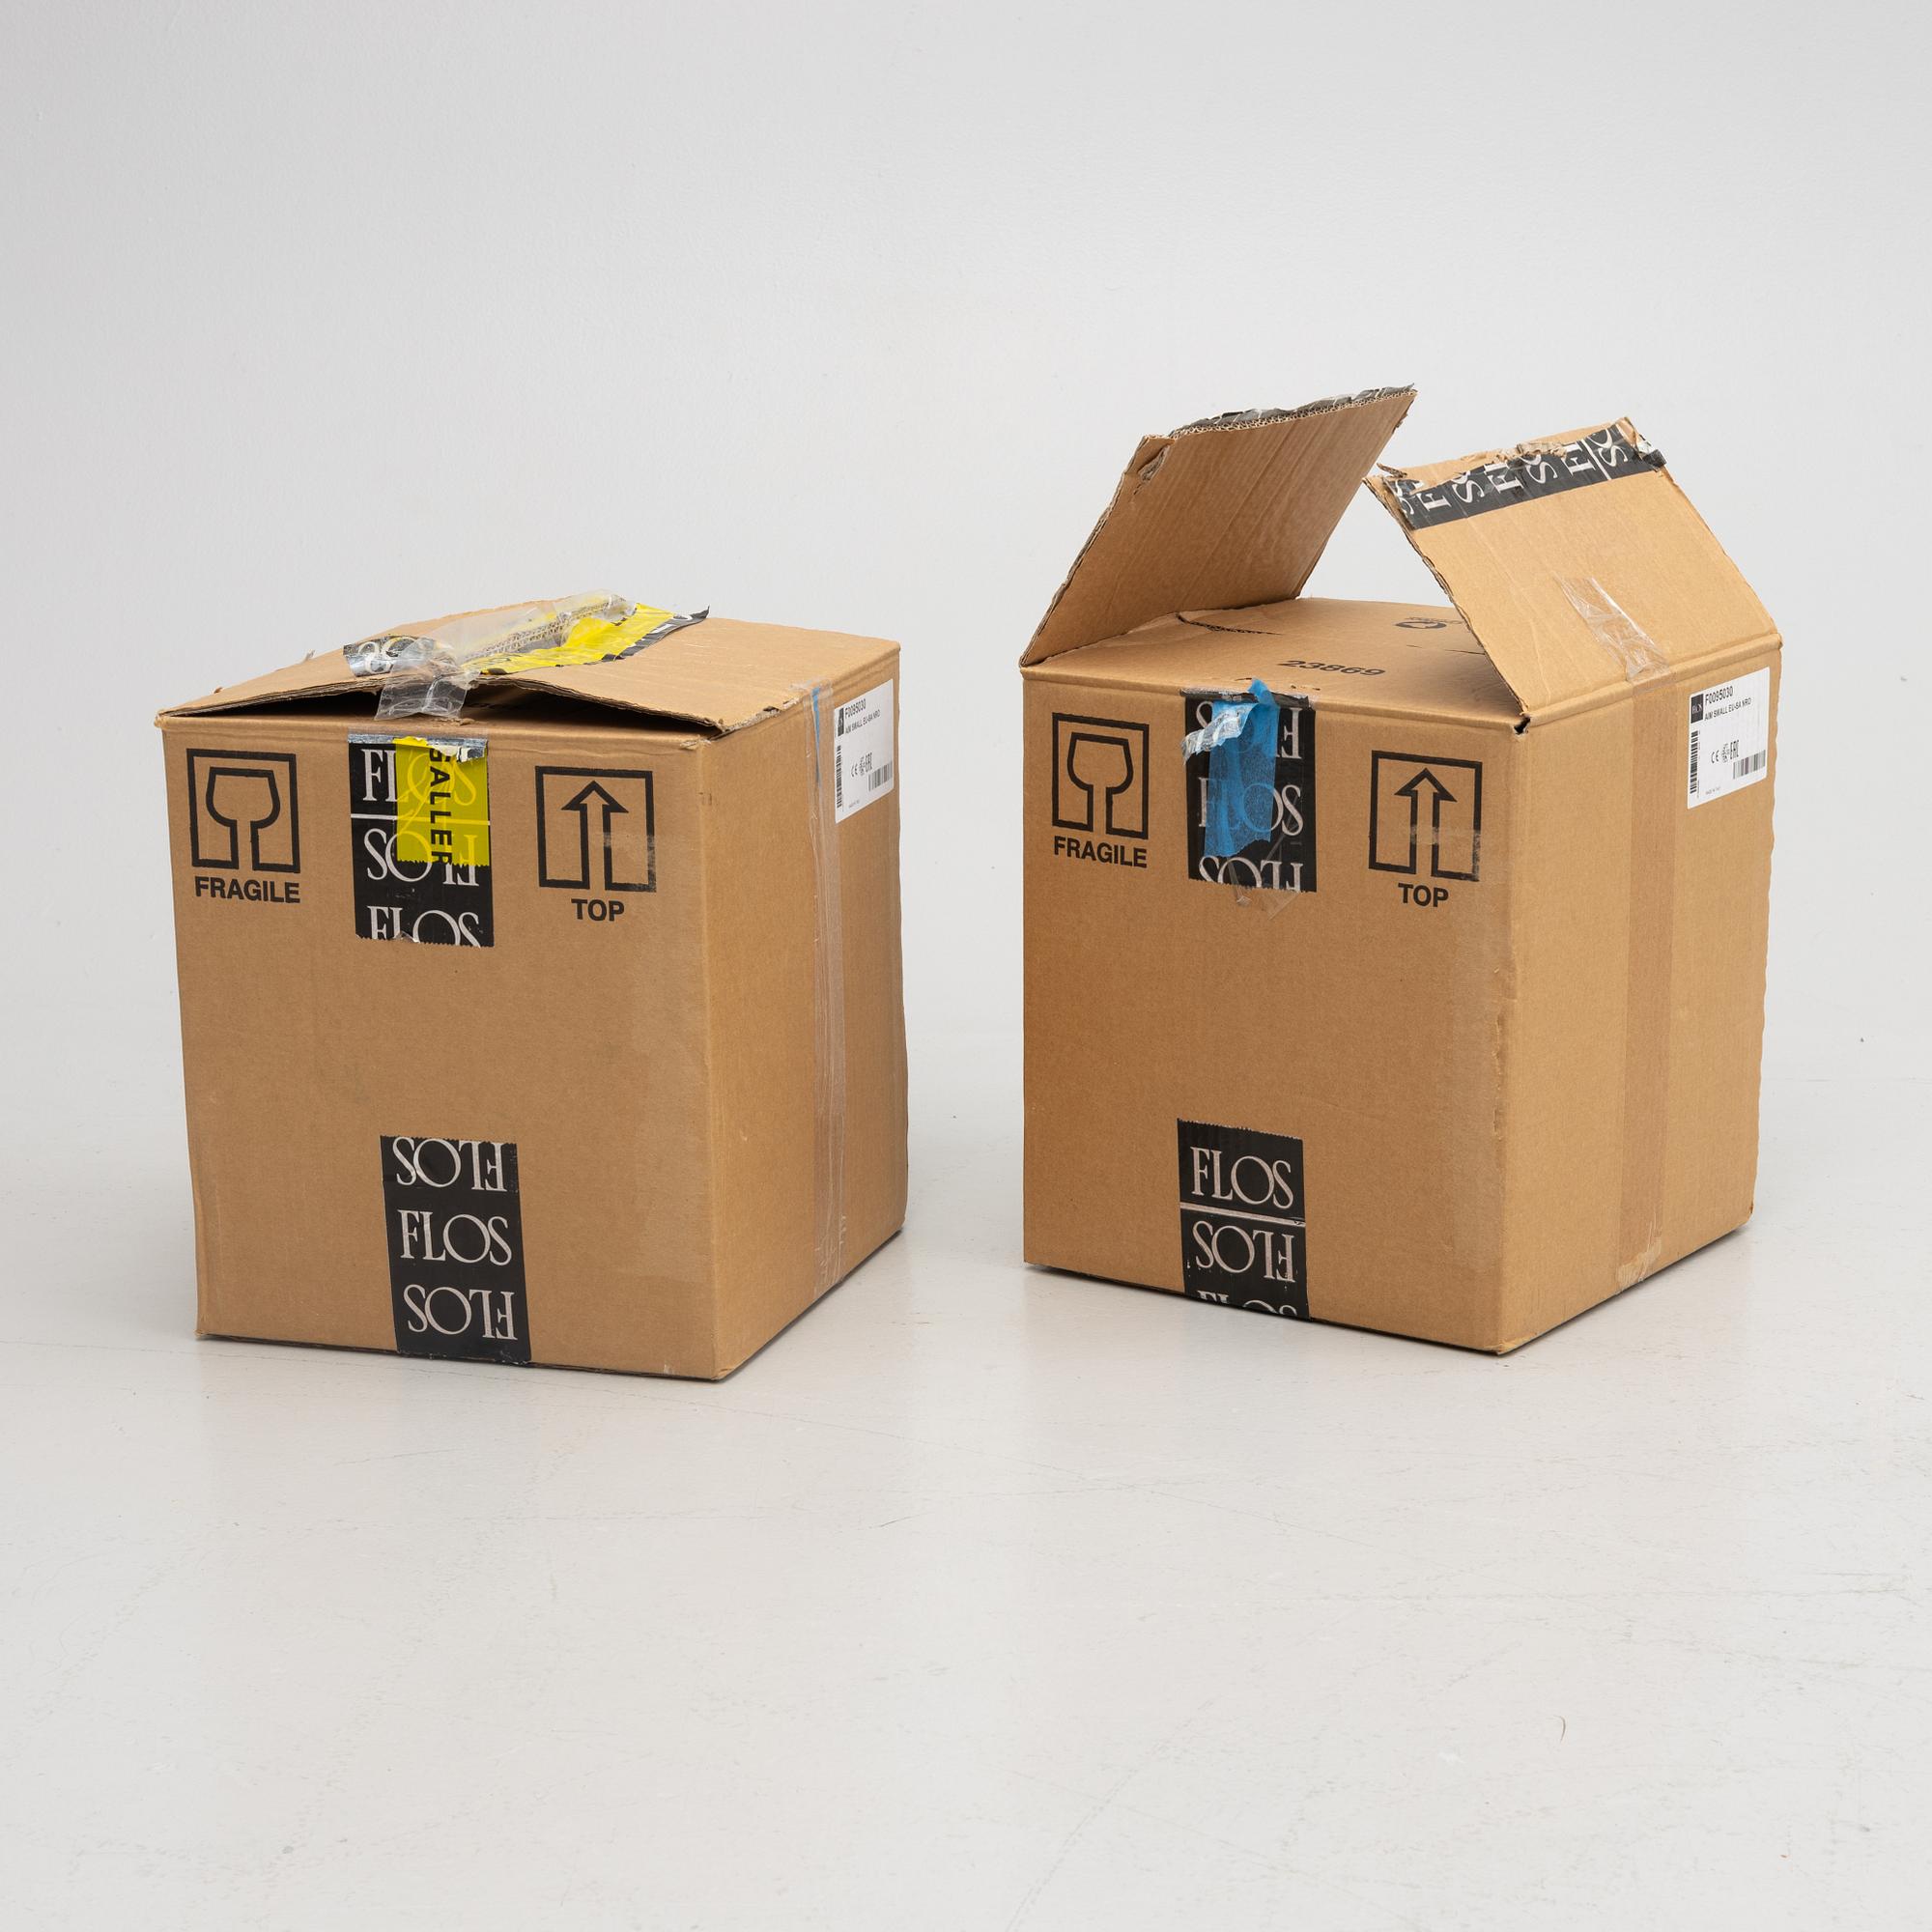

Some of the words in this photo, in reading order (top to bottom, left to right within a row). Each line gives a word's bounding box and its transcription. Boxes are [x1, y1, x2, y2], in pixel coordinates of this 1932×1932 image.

[1278, 660, 1385, 675] 23869
[1053, 836, 1149, 868] FRAGILE
[194, 876, 300, 903] FRAGILE
[571, 898, 625, 922] TOP
[1398, 883, 1449, 908] TOP
[392, 1136, 508, 1192] FLOS
[1190, 1146, 1294, 1209] FLOS
[397, 1208, 513, 1266] FLOS
[1192, 1220, 1295, 1283] FLOS
[403, 1284, 519, 1341] FLOS
